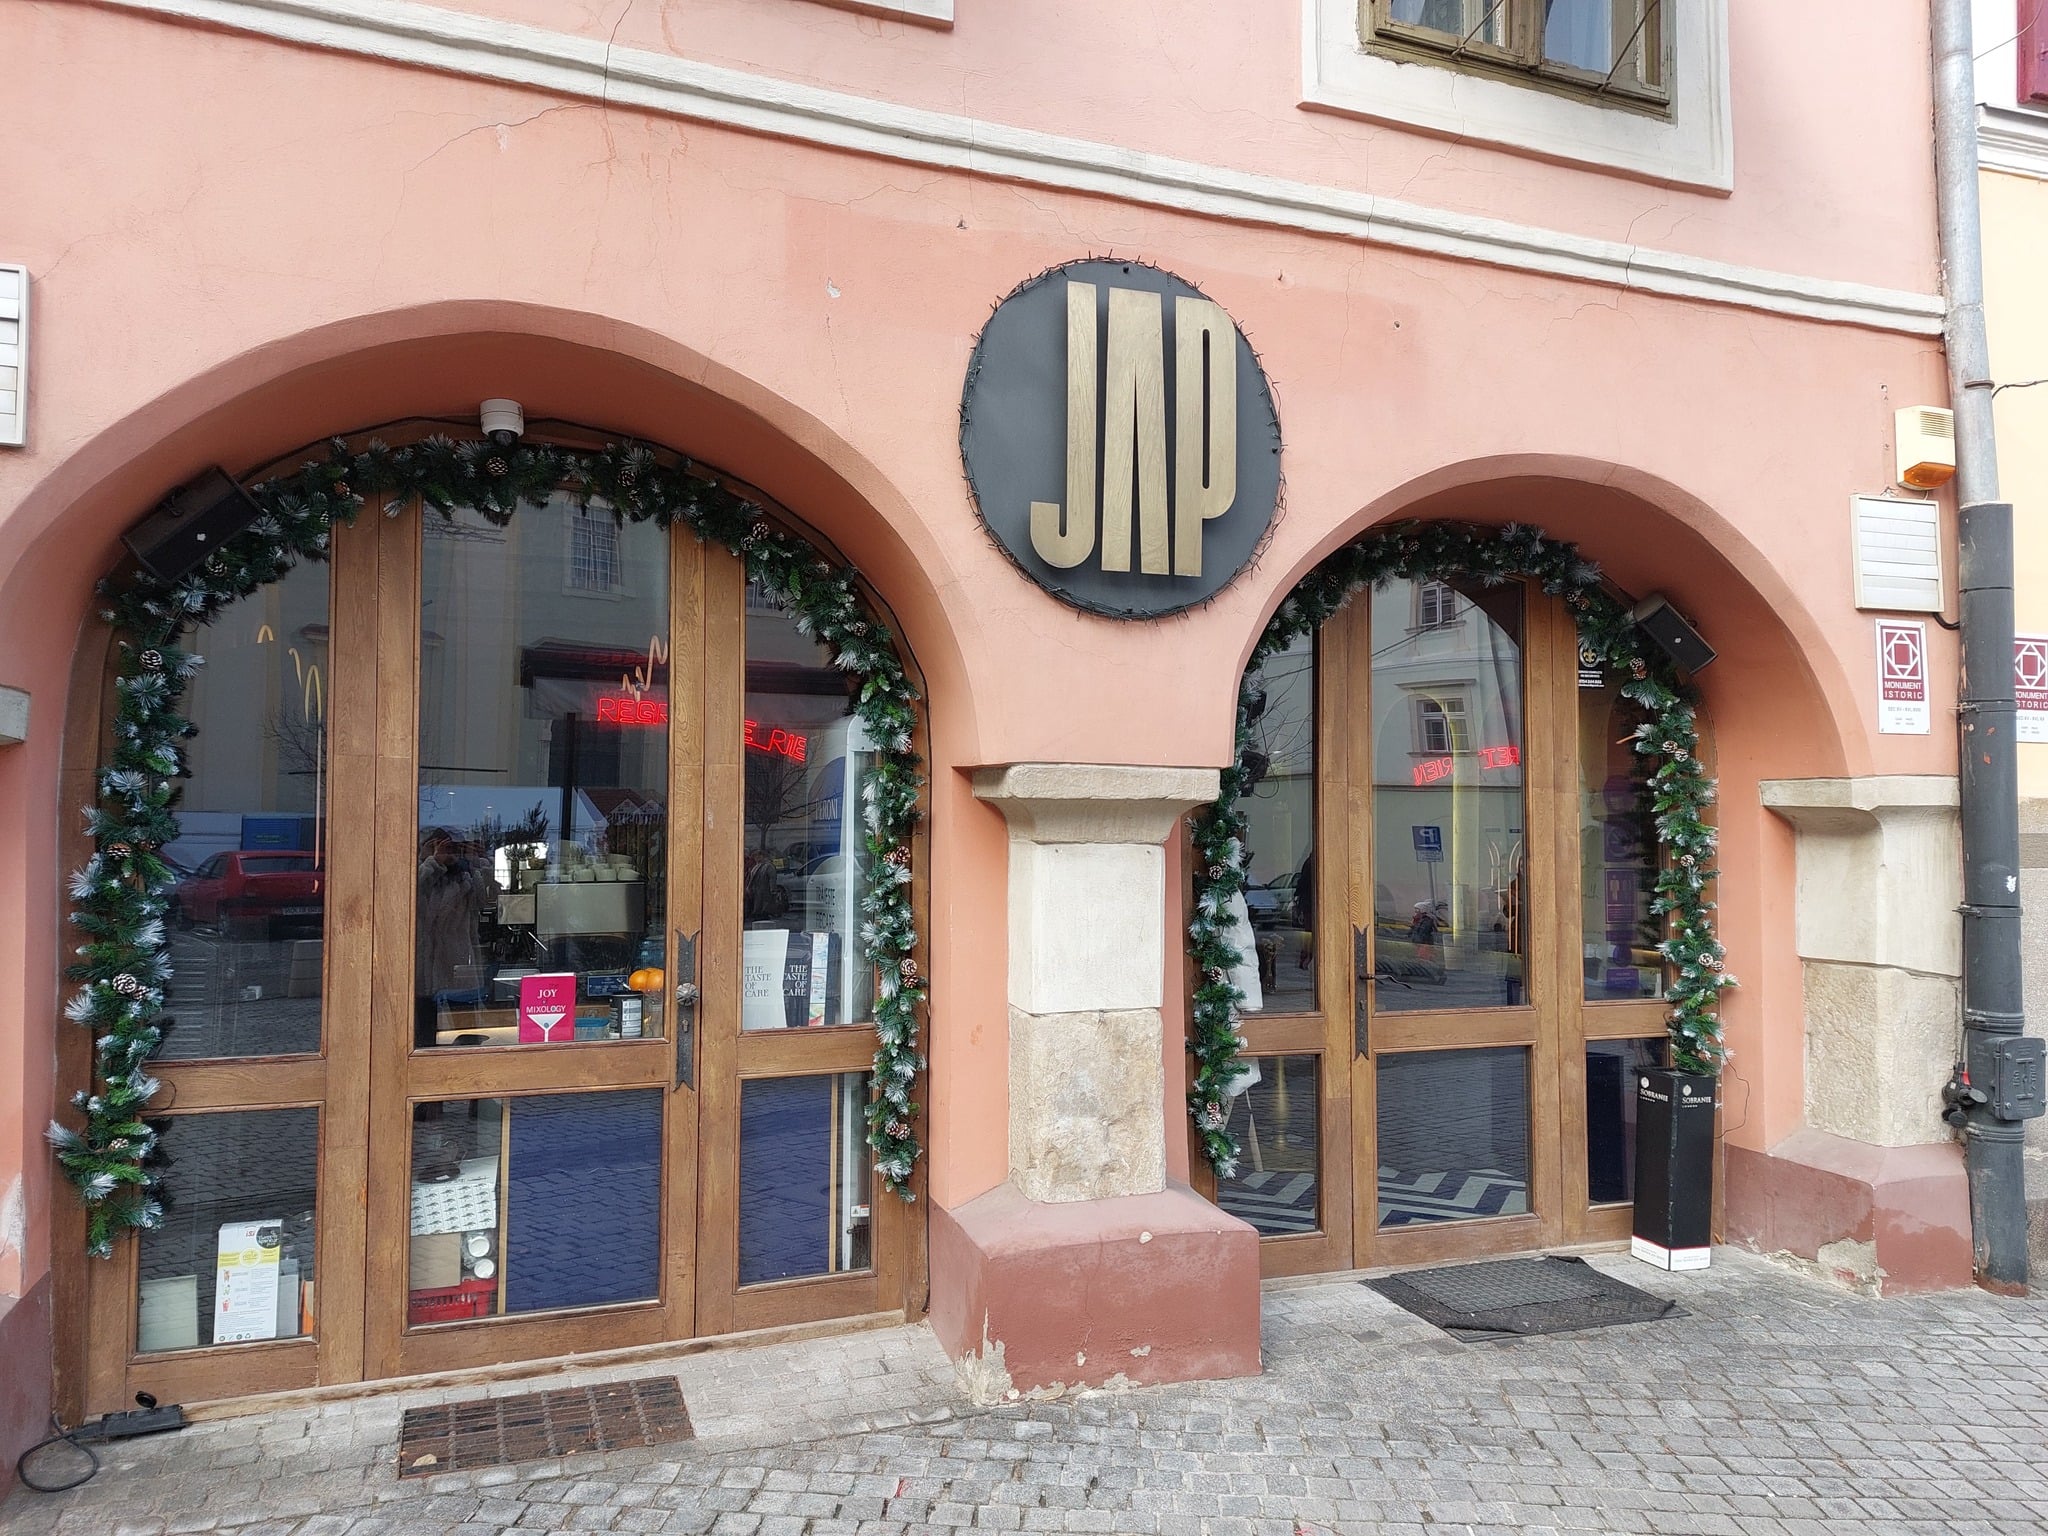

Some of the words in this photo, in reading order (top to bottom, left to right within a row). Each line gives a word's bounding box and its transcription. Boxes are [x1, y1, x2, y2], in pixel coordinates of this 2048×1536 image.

[1884, 681, 1923, 690] MONUMENT
[1884, 690, 1923, 700] ISTORIC
[745, 966, 763, 974] THE
[789, 964, 808, 973] THE
[745, 973, 772, 982] TASTE
[745, 981, 758, 990] OF
[537, 989, 557, 999] JOY
[745, 989, 769, 998] CARE
[526, 1005, 566, 1014] MIXOLOGY
[1640, 1088, 1669, 1103] SOBRANIE
[1682, 1096, 1712, 1104] SOBRANIE
